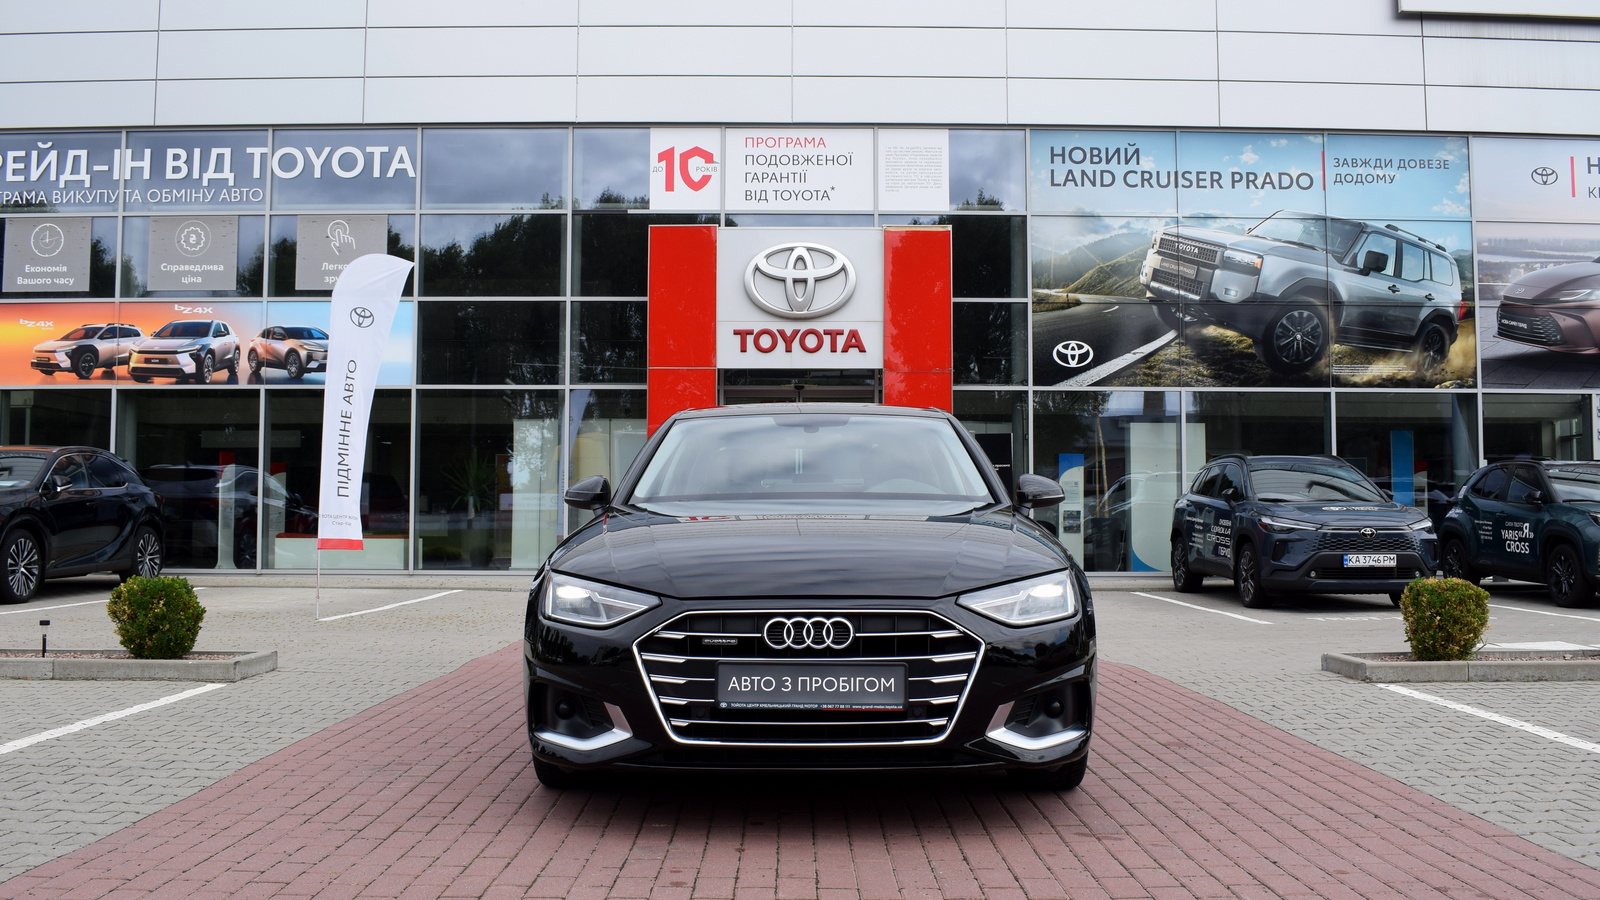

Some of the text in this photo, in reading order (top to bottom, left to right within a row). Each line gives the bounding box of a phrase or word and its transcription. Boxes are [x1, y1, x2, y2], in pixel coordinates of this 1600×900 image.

[744, 136, 827, 149] ПРОГРАМА
[744, 151, 854, 168] ПОДОВЖЕНОЇ
[1049, 142, 1141, 166] НОВИЙ
[0, 141, 416, 189] ЕЙД-ІН ВІД TOYOTA
[1333, 157, 1450, 171] ЗАВЖДИ ДОВЕЗЕ
[744, 169, 808, 184] ГАРАНТІЇ
[1049, 169, 1314, 191] LAND CRUISER PRADO
[1333, 172, 1397, 186] ДОДОМУ
[0, 187, 264, 204] РАМА ВИКУПУ ТА ОБМІНУ АВТО
[744, 189, 769, 203] ВІД
[1588, 186, 1600, 199] К
[1175, 242, 1199, 254] TOYOTA
[25, 264, 68, 273] Економія
[160, 262, 224, 273] Справедлива
[17, 276, 75, 286] Вашого часу
[181, 274, 202, 285] ціна
[733, 328, 867, 353] TOYOTA
[337, 359, 357, 498] ПІДМІННЕ АВТО
[1210, 525, 1231, 535] COROLLA
[1500, 529, 1519, 540] YARIS
[1206, 533, 1231, 546] CROSS
[1505, 540, 1530, 554] CROSS
[1348, 555, 1396, 564] KA 3746 PM
[727, 676, 896, 692] АВТО З ПРОБІГОМ
